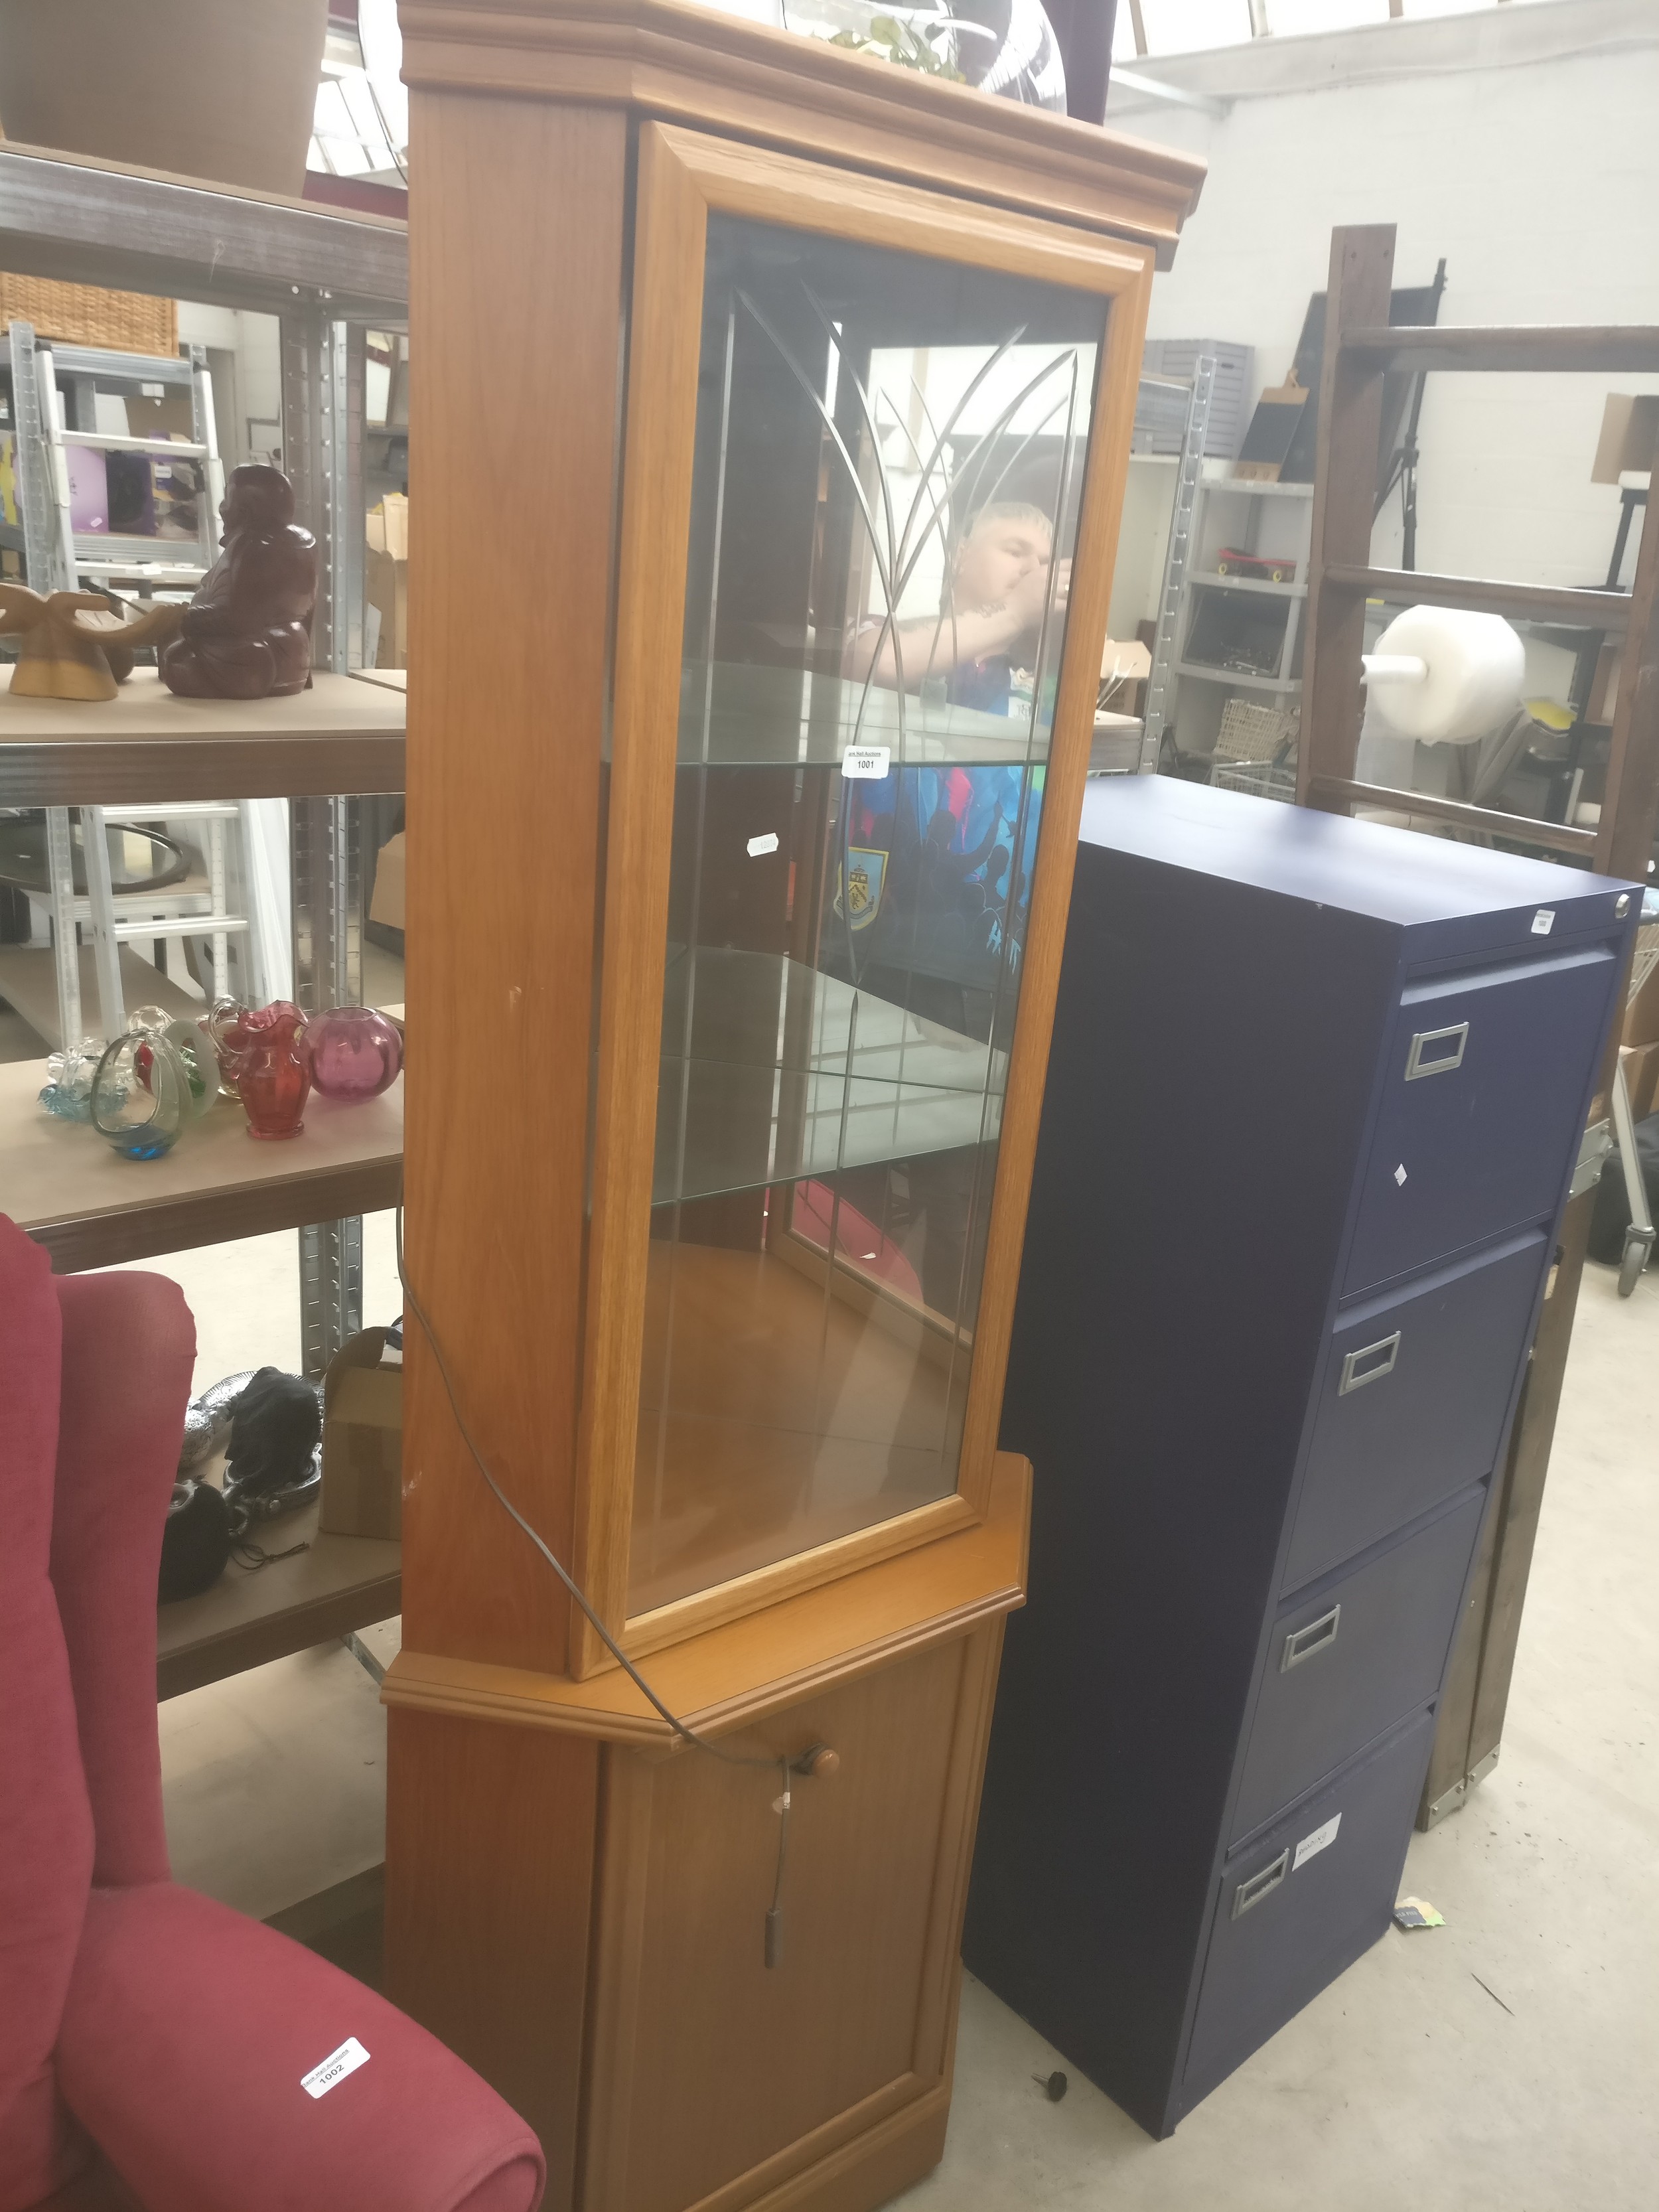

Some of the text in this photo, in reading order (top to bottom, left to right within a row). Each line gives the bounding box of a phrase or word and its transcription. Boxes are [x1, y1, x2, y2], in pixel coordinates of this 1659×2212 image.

[315, 2067, 326, 2077] Hall
[326, 2049, 349, 2069] Auctions
[319, 2064, 344, 2085] 1002
